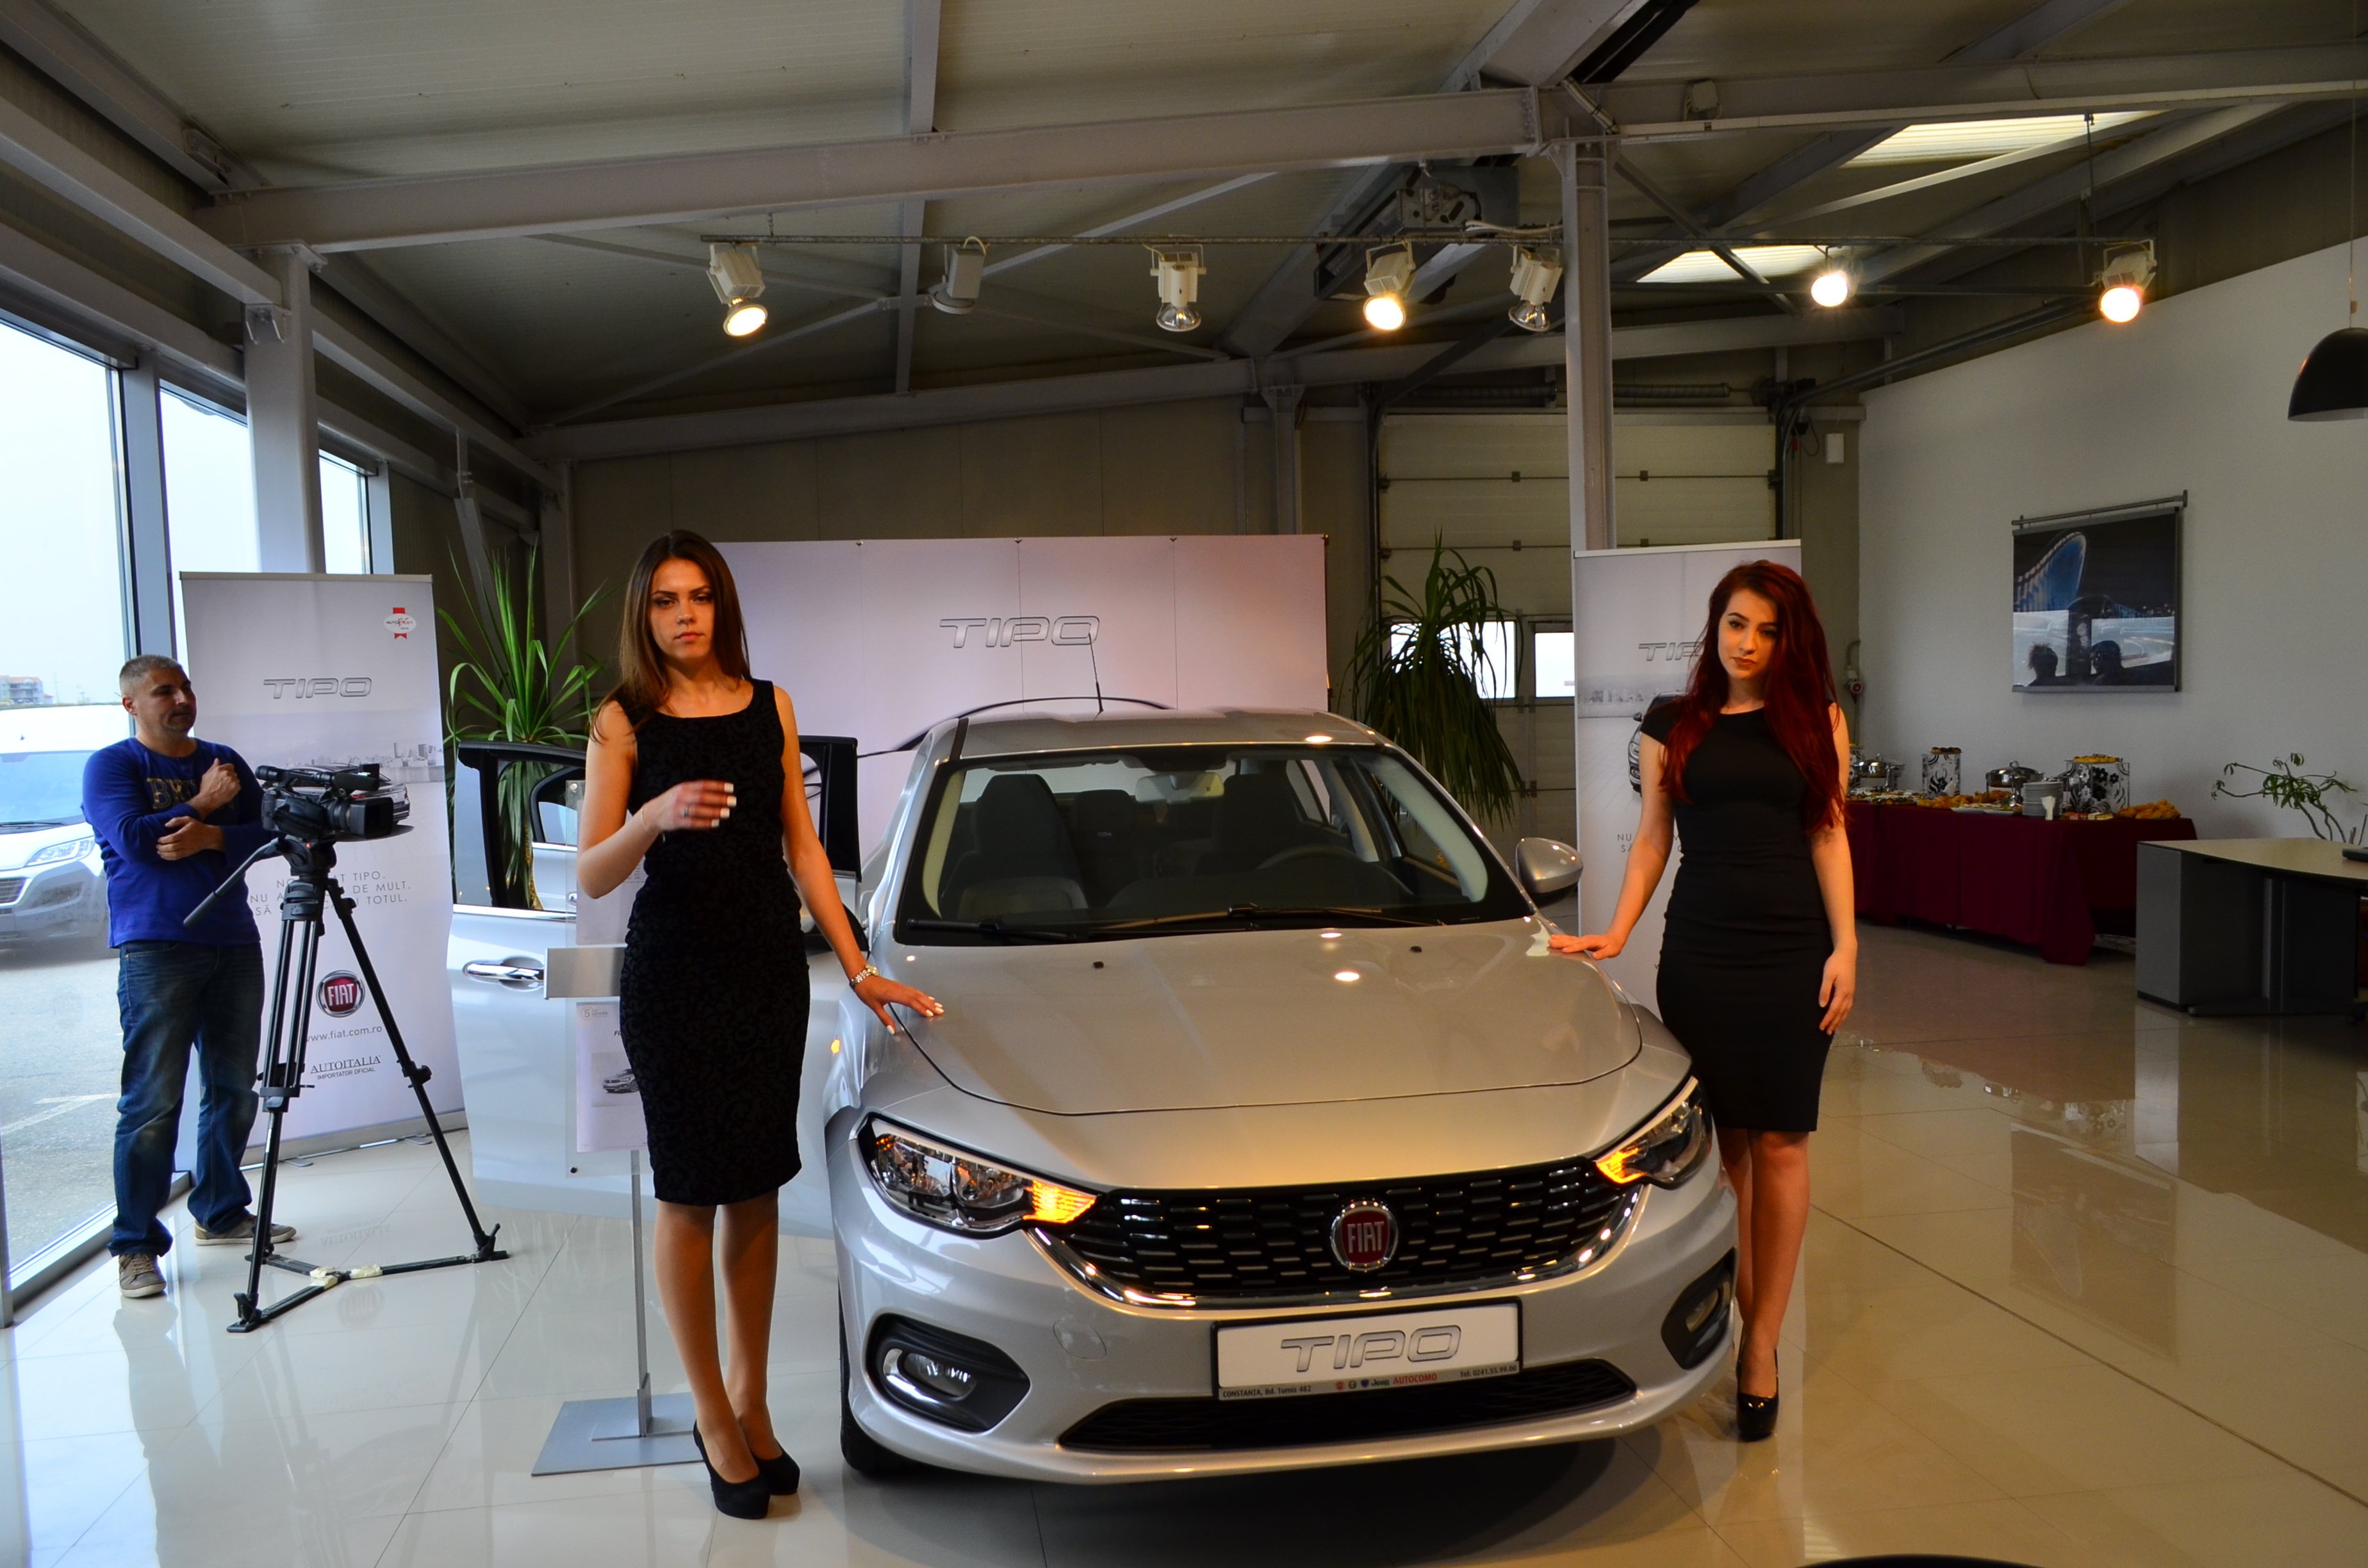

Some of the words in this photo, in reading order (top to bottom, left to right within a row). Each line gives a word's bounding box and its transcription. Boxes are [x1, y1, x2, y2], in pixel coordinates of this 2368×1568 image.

[940, 616, 1099, 648] TIPO
[263, 677, 372, 699] TIPO
[353, 870, 385, 881] TIPO.
[251, 894, 268, 902] NU
[353, 884, 368, 894] DE
[256, 904, 272, 916] SĂ
[366, 894, 407, 904] TOTUL.
[327, 984, 354, 1006] FIAT
[317, 1070, 353, 1080] IMPORTATOR
[354, 1066, 375, 1075] OFICIAL
[1347, 1221, 1385, 1254] FIAT
[1281, 1325, 1461, 1372] TIPO
[1278, 1385, 1297, 1394] Tomis
[1393, 1373, 1437, 1385] AUTOCOMO
